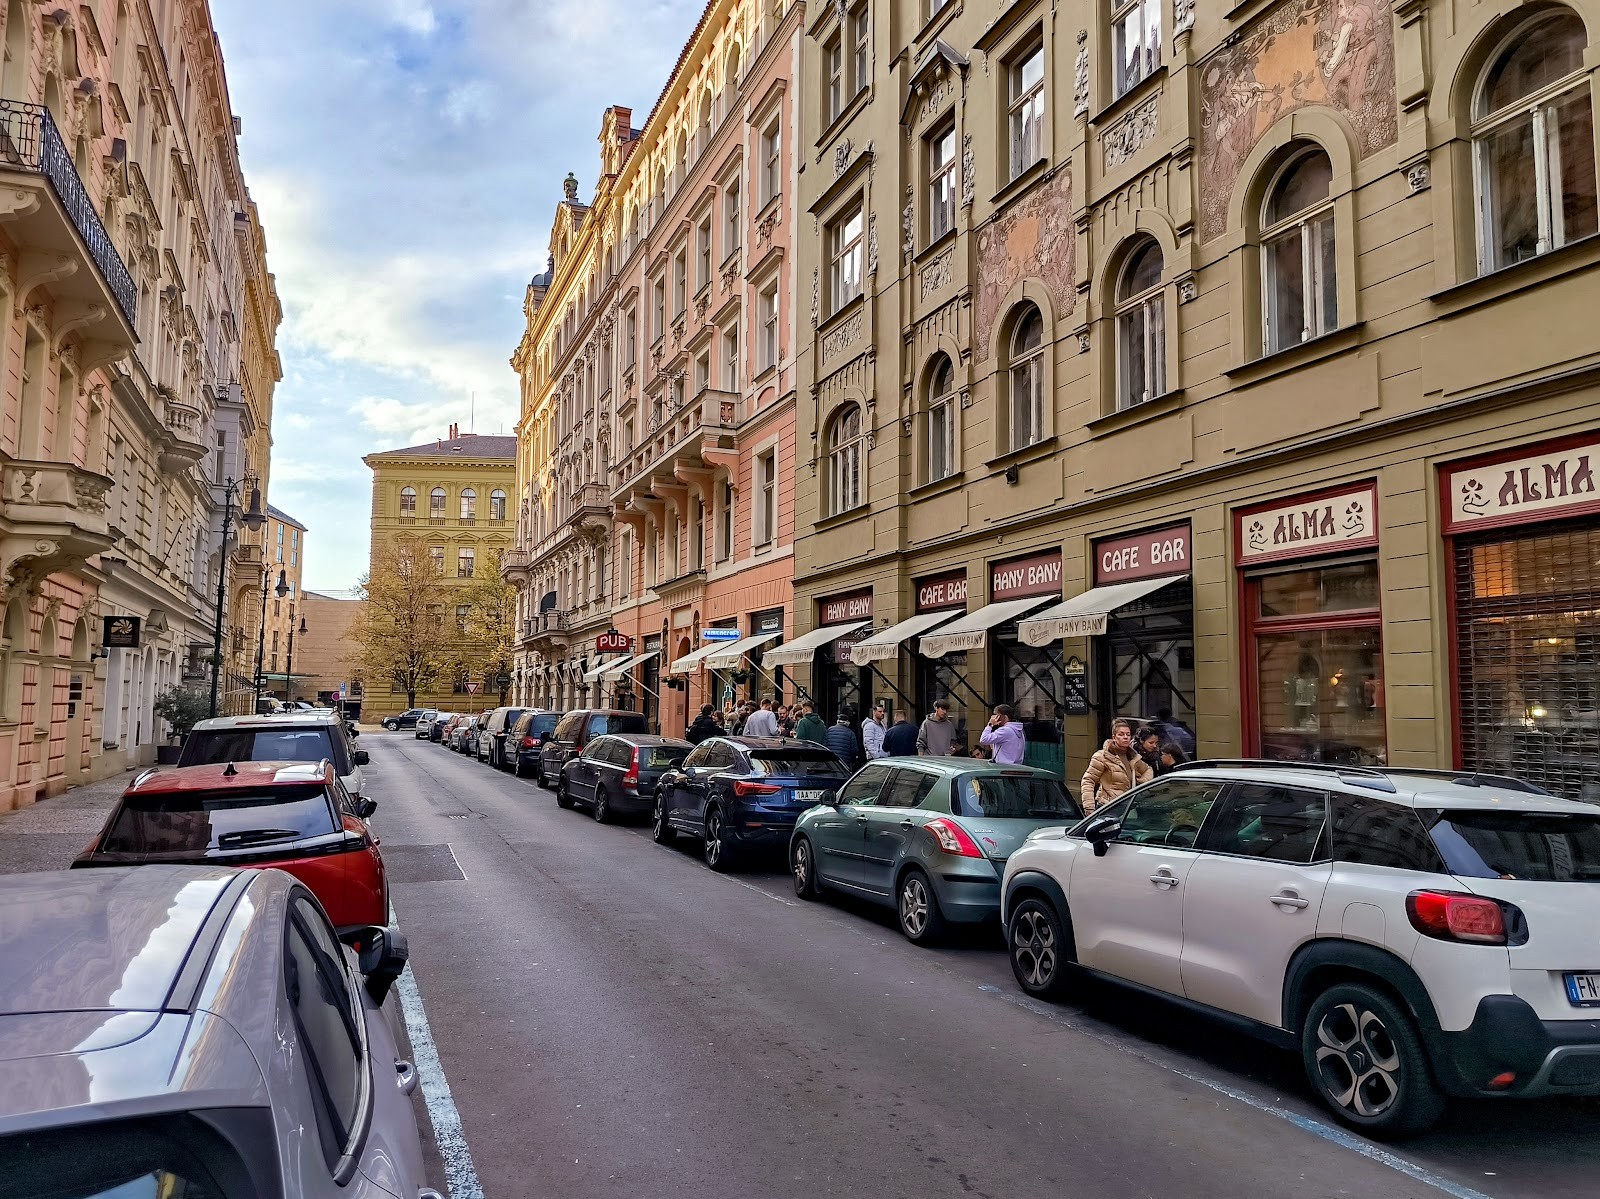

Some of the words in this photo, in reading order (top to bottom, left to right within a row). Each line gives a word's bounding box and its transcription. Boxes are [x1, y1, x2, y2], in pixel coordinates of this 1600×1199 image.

[1497, 455, 1597, 507] ALMA
[1273, 506, 1336, 545] ALMA
[1102, 546, 1139, 573] CAFE
[1150, 537, 1185, 565] BAR
[993, 568, 1024, 592] HANY
[1028, 561, 1062, 585] BANY
[919, 582, 945, 606] CAFE
[947, 579, 968, 601] BAR
[827, 602, 846, 620] HANY
[849, 598, 870, 616] BANY
[1058, 620, 1079, 634] HANY
[1081, 618, 1103, 631] BANY
[600, 635, 627, 647] PUB
[967, 634, 983, 645] BANY
[1576, 976, 1598, 998] FN
